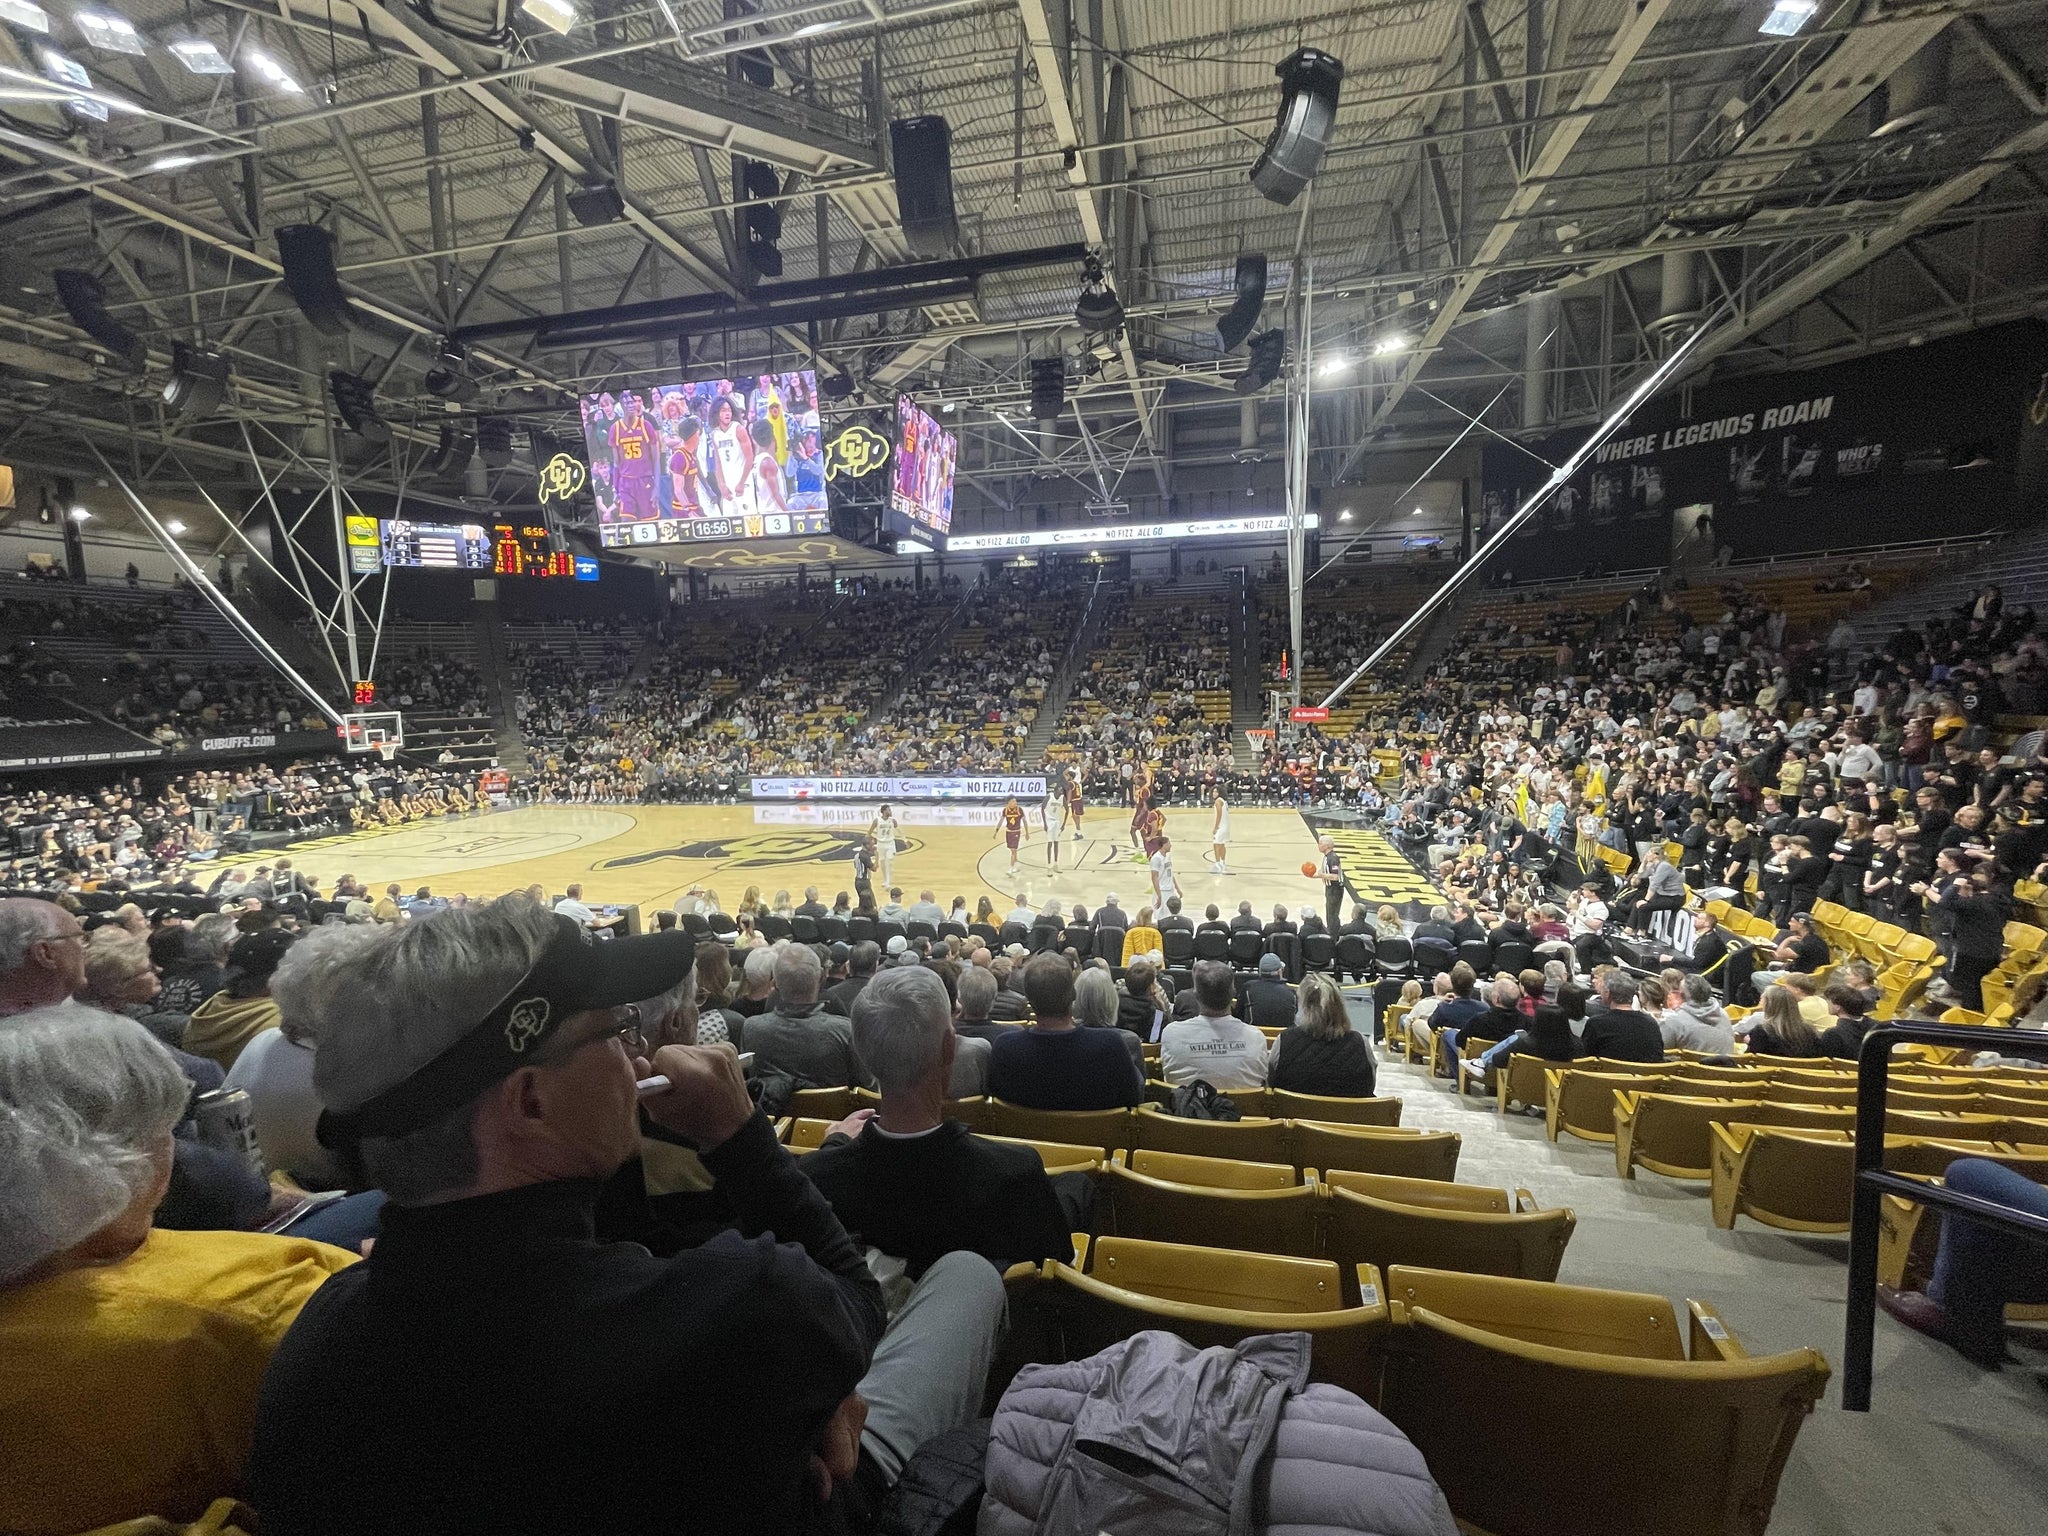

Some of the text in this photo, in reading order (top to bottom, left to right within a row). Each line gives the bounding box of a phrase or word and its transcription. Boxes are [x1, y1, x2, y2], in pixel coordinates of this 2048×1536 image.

[1597, 396, 1834, 463] WHERE LEGENDS ROAM
[624, 442, 642, 459] 35
[1837, 444, 1882, 462] WHO'S
[696, 521, 729, 536] 16:56
[774, 518, 782, 530] 3
[641, 528, 649, 539] 5
[355, 690, 373, 703] 22
[202, 735, 276, 751] CUBUFFS.COM
[821, 781, 833, 792] NO
[835, 781, 857, 792] FIZZ.
[858, 781, 874, 793] ALL
[876, 781, 891, 793] GO.
[967, 781, 981, 793] NO
[983, 781, 1006, 793] FIZZ.
[1008, 781, 1025, 793] ALL
[1027, 781, 1043, 793] GO.
[1190, 1043, 1228, 1051] WILHITE
